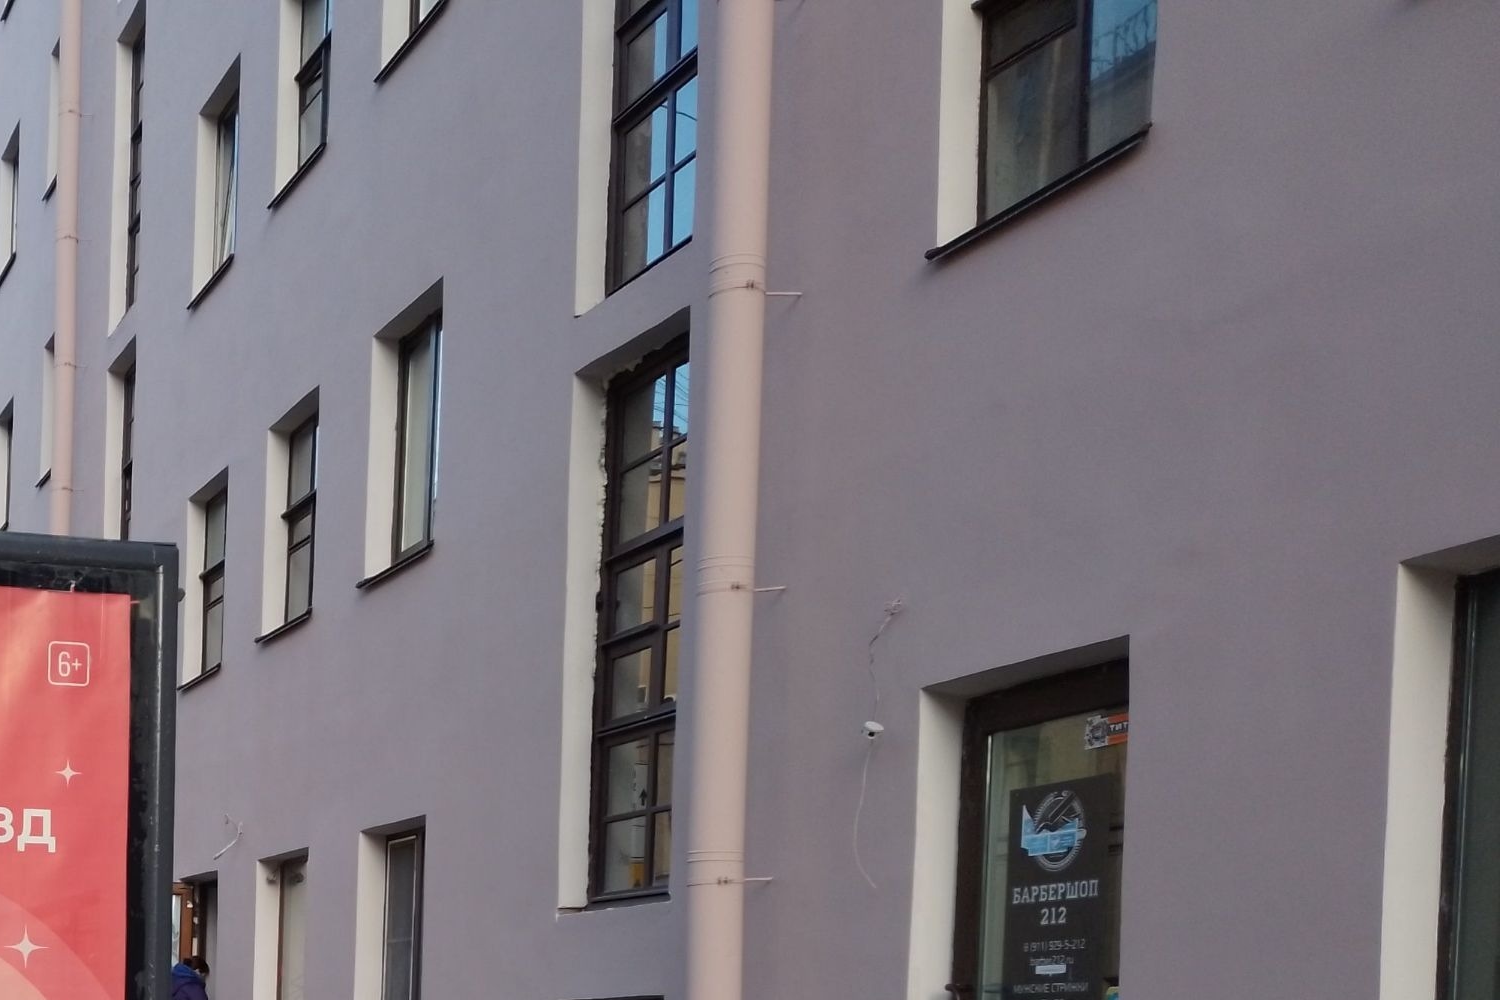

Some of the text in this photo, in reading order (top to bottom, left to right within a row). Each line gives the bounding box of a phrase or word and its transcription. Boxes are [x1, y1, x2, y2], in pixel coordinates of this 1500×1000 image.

[57, 651, 83, 678] 6+
[1012, 880, 1098, 904] БАРБЕРШОП
[1040, 907, 1066, 925] 212
